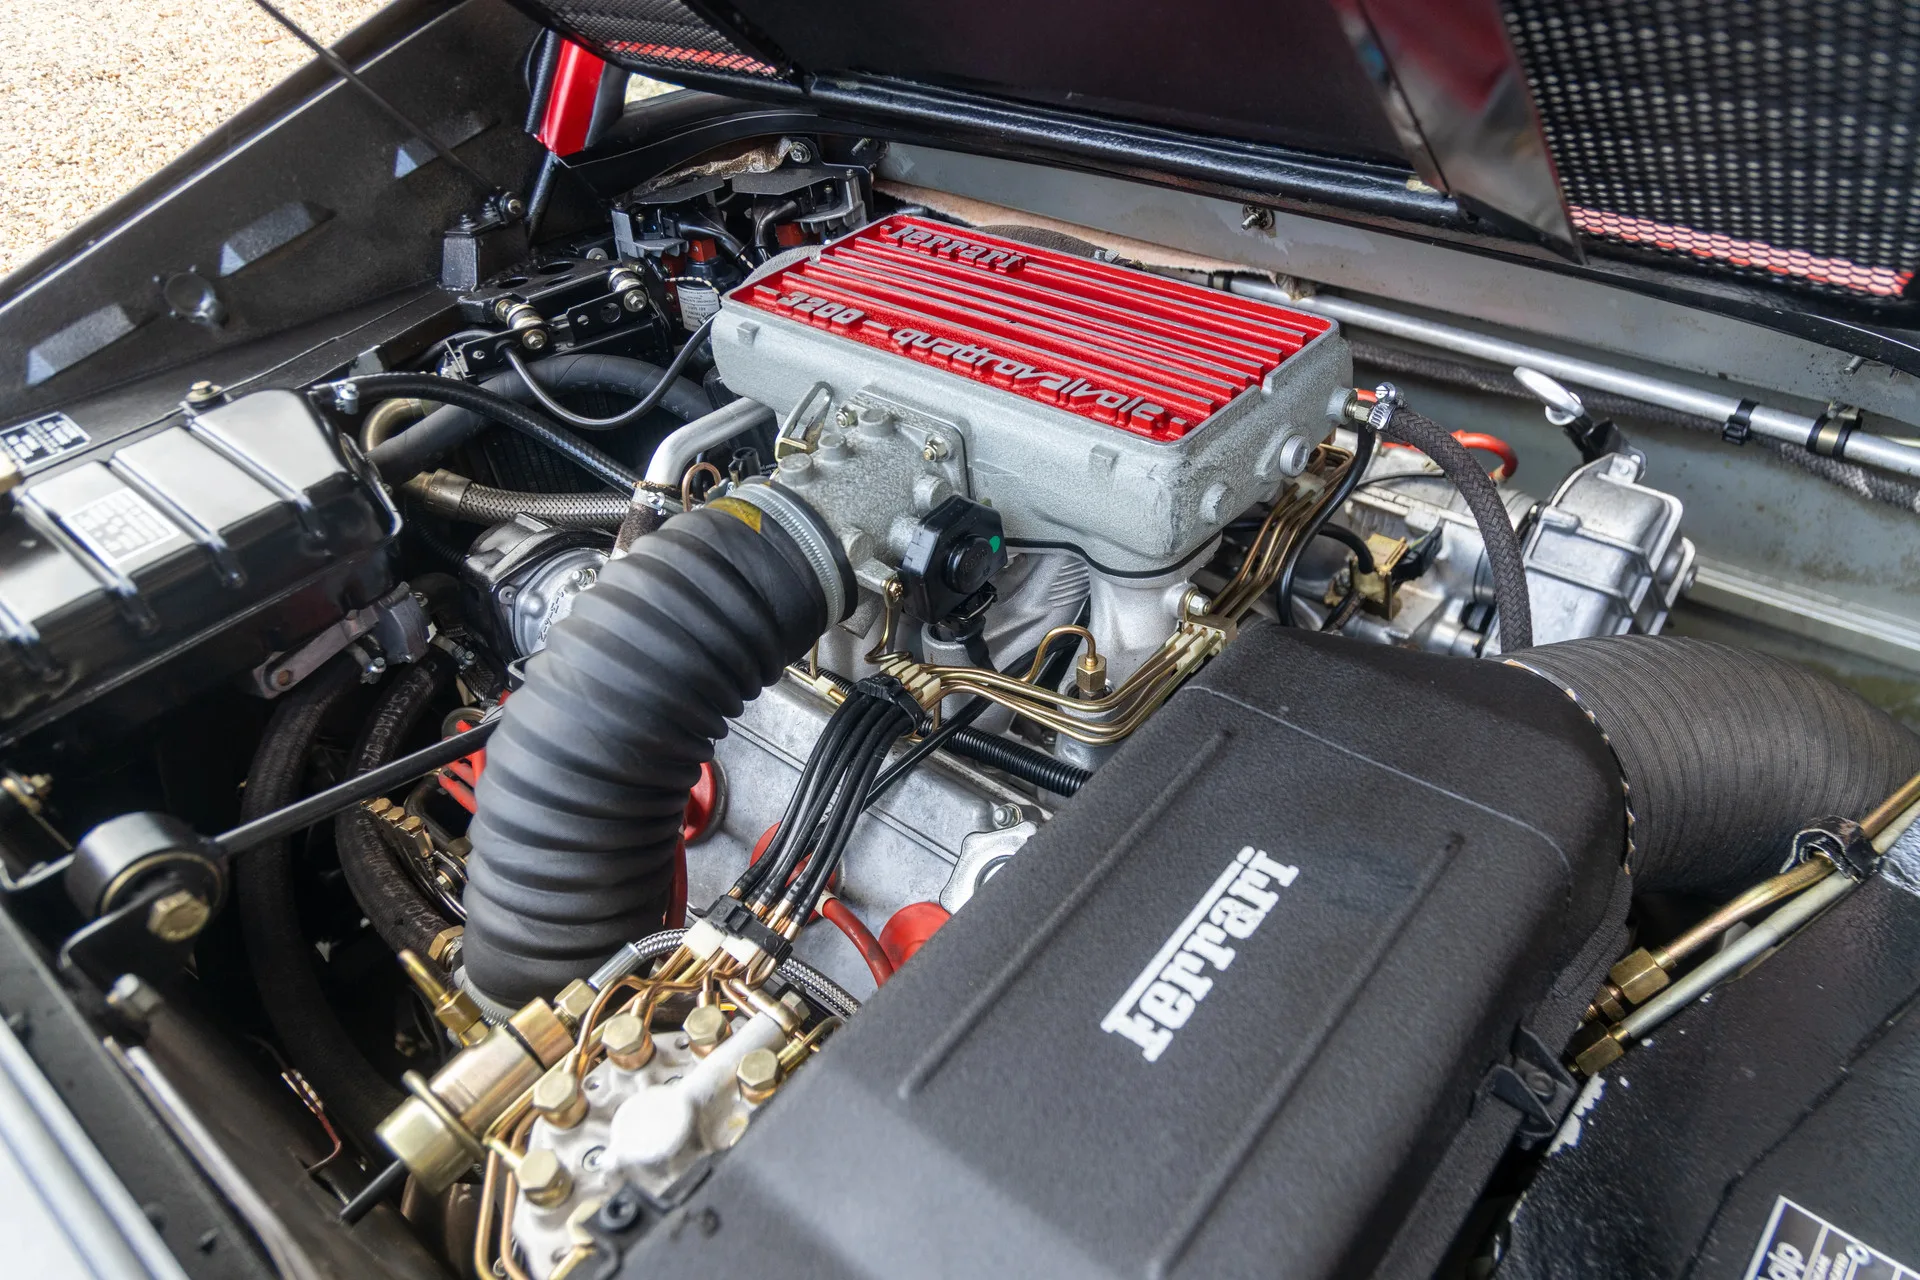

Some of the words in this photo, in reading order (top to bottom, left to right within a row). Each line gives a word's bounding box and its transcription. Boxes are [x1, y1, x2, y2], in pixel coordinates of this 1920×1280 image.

[888, 224, 1027, 271] Ferrari
[780, 290, 864, 329] 3200
[893, 327, 1165, 422] quattrovalvole
[1100, 845, 1300, 1062] Ferrari
